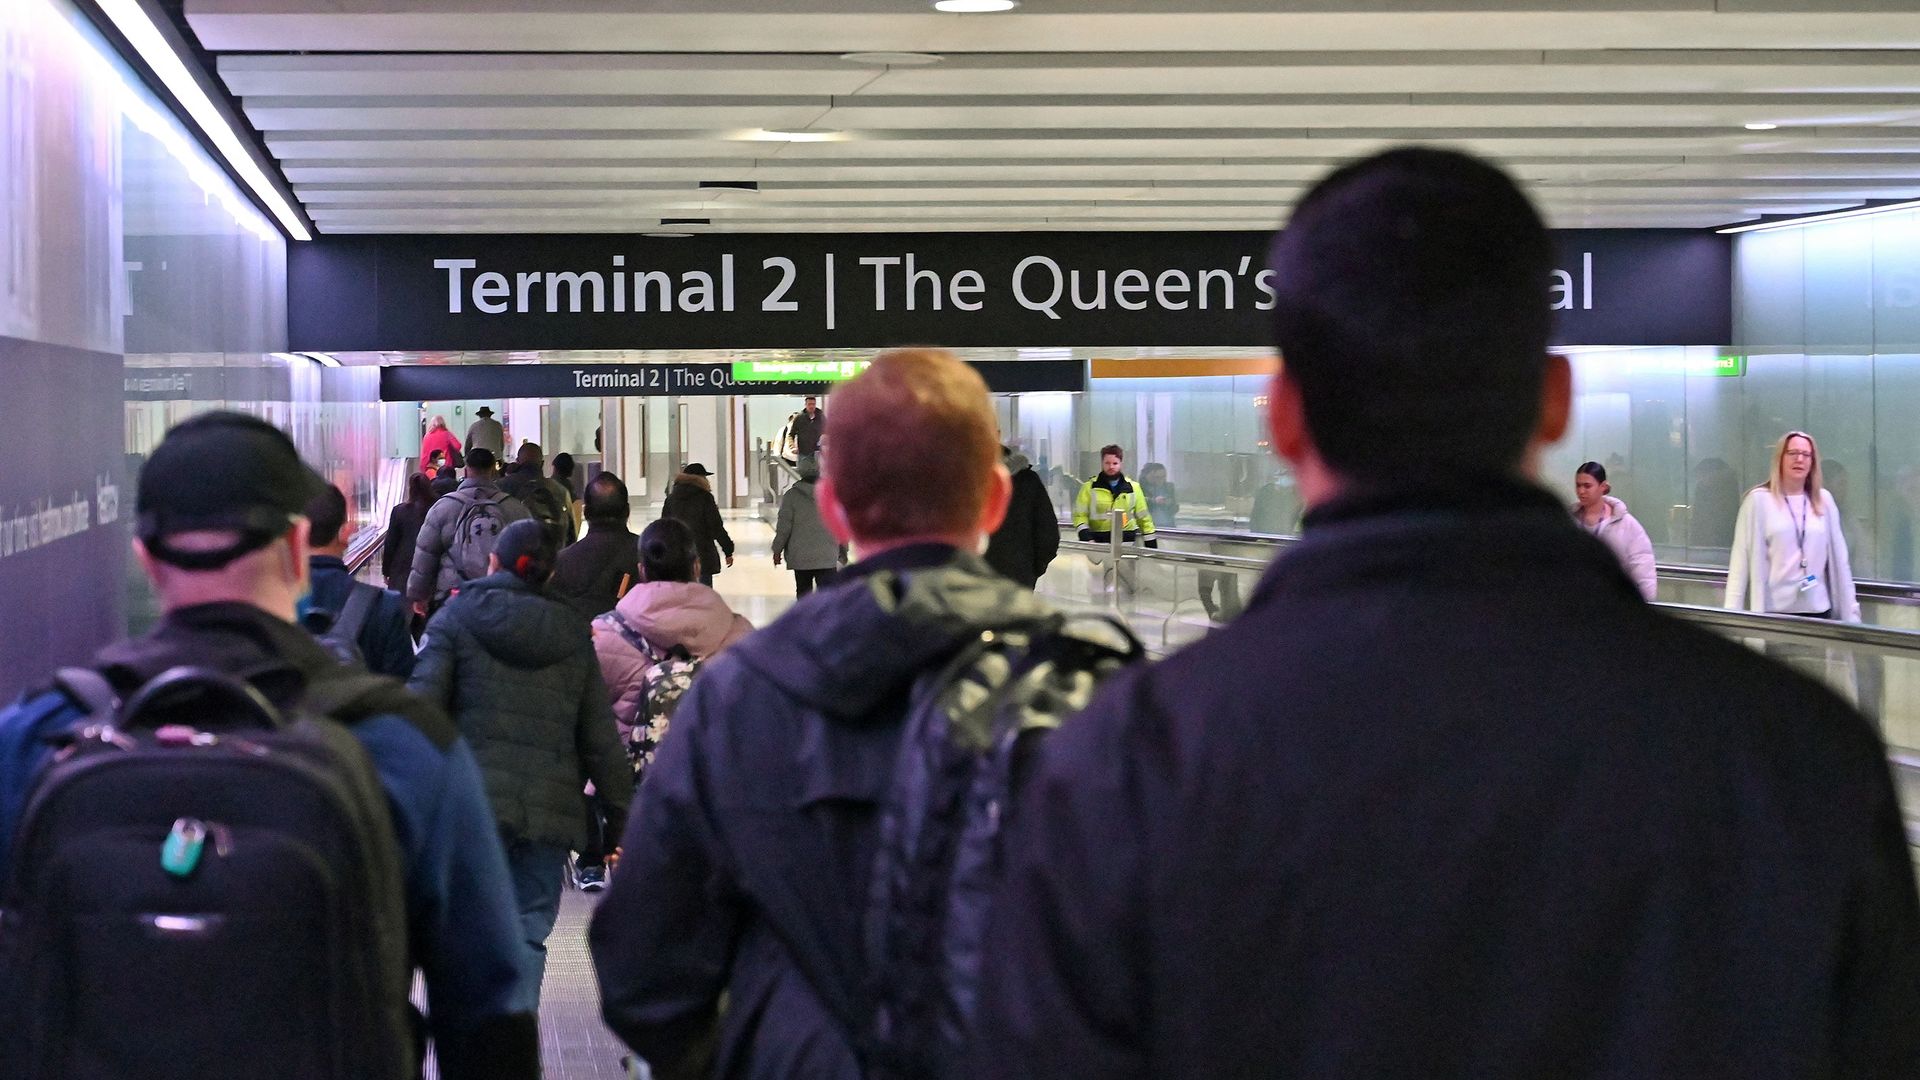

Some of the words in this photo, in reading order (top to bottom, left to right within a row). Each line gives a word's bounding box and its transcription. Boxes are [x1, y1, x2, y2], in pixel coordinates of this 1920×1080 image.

[433, 253, 735, 314] Terminal
[761, 256, 799, 312] 2
[858, 252, 986, 311] The
[1011, 255, 1278, 320] Queen's
[572, 368, 645, 388] Terminal
[649, 368, 660, 387] 2
[673, 367, 706, 387] The
